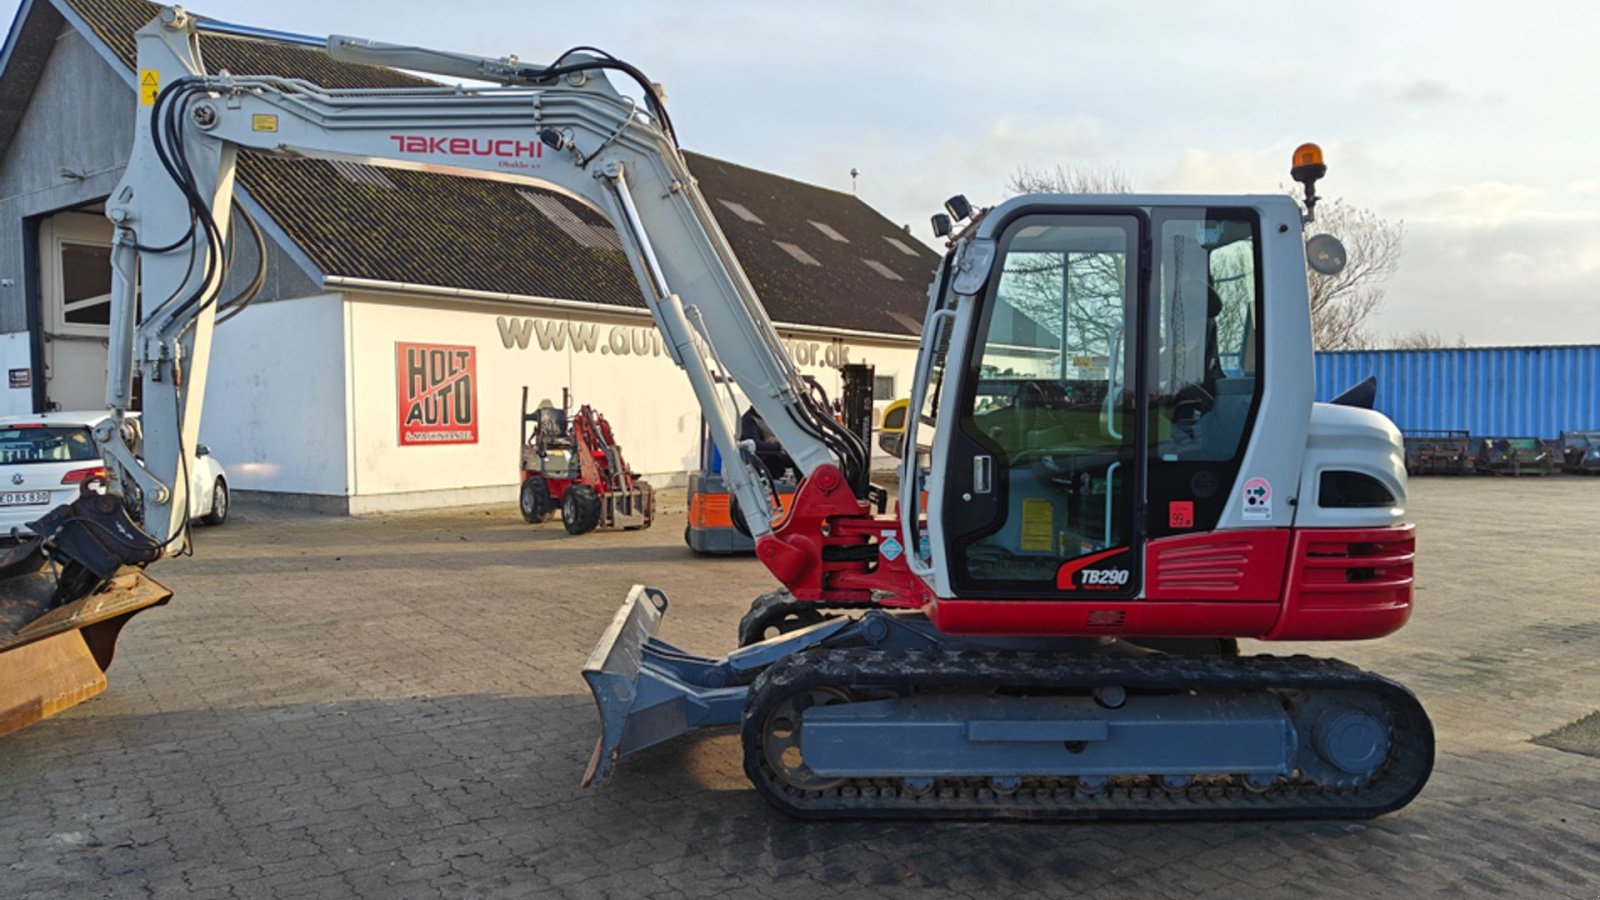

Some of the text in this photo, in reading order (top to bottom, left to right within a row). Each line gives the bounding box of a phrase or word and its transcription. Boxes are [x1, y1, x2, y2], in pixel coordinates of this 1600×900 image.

[405, 374, 471, 426] AUTO
[407, 348, 470, 400] HOLT
[1081, 569, 1129, 584] TB290
